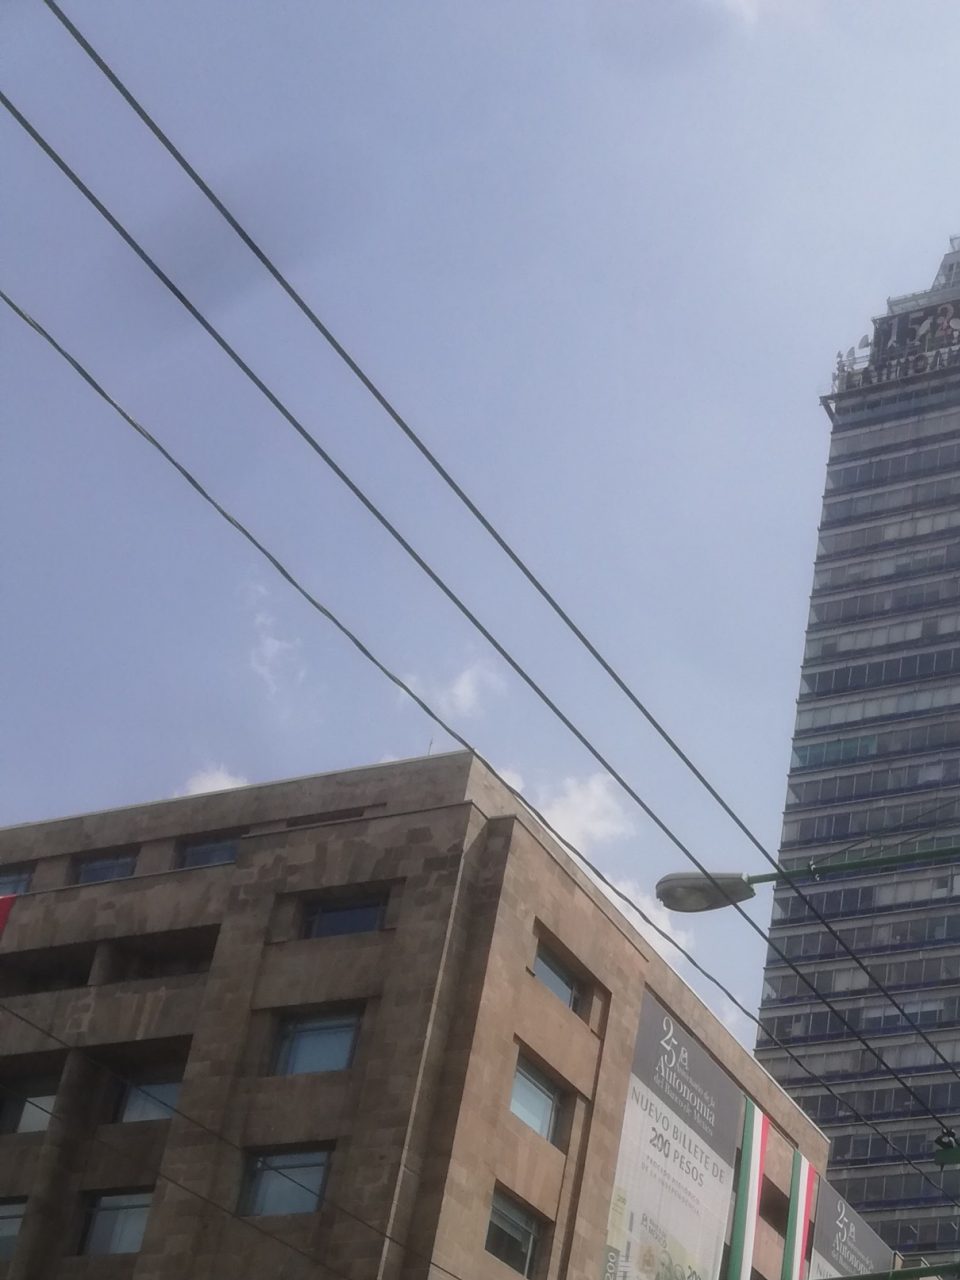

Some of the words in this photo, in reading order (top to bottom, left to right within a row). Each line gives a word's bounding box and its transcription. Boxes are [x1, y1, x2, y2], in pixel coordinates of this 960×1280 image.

[660, 1016, 678, 1068] 25
[631, 1087, 670, 1131] NUEVO
[673, 1124, 711, 1170] BILLETE
[712, 1159, 725, 1184] DE
[649, 1127, 671, 1159] 200
[673, 1150, 704, 1188] PESOS
[835, 1199, 848, 1243] 25
